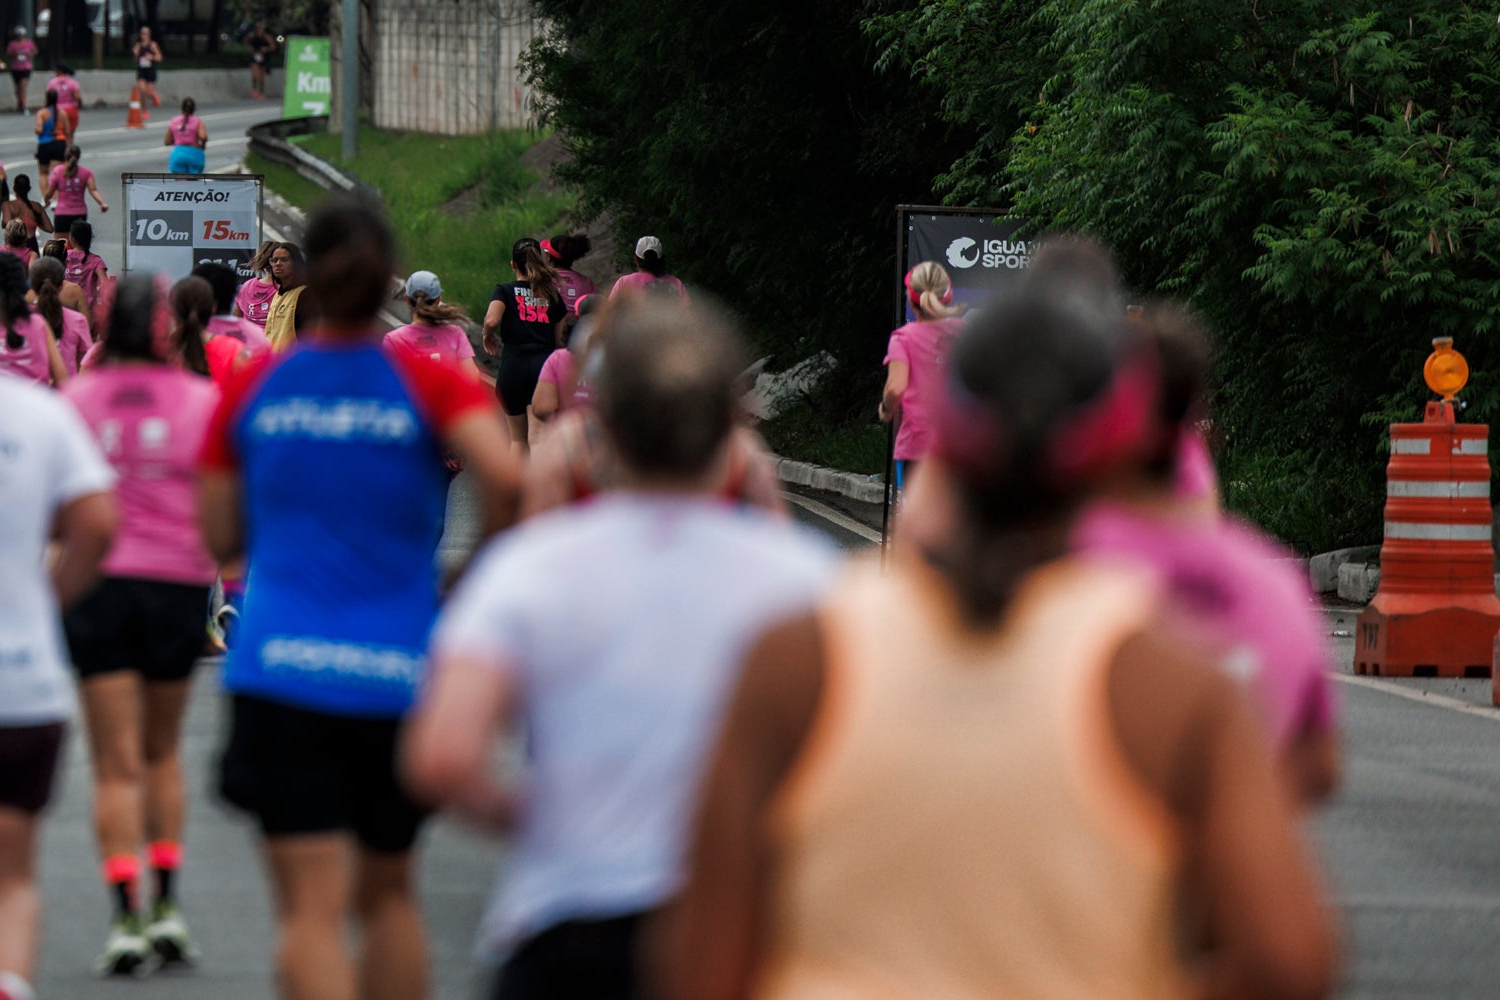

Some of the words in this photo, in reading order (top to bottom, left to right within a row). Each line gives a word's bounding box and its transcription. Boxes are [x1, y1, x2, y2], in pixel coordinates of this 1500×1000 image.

[297, 71, 332, 94] Km
[155, 189, 230, 203] ATENÇÃO!
[136, 218, 189, 241] 10km
[203, 220, 250, 241] 15km
[983, 239, 1040, 255] IGUA
[981, 254, 1032, 269] SPOR
